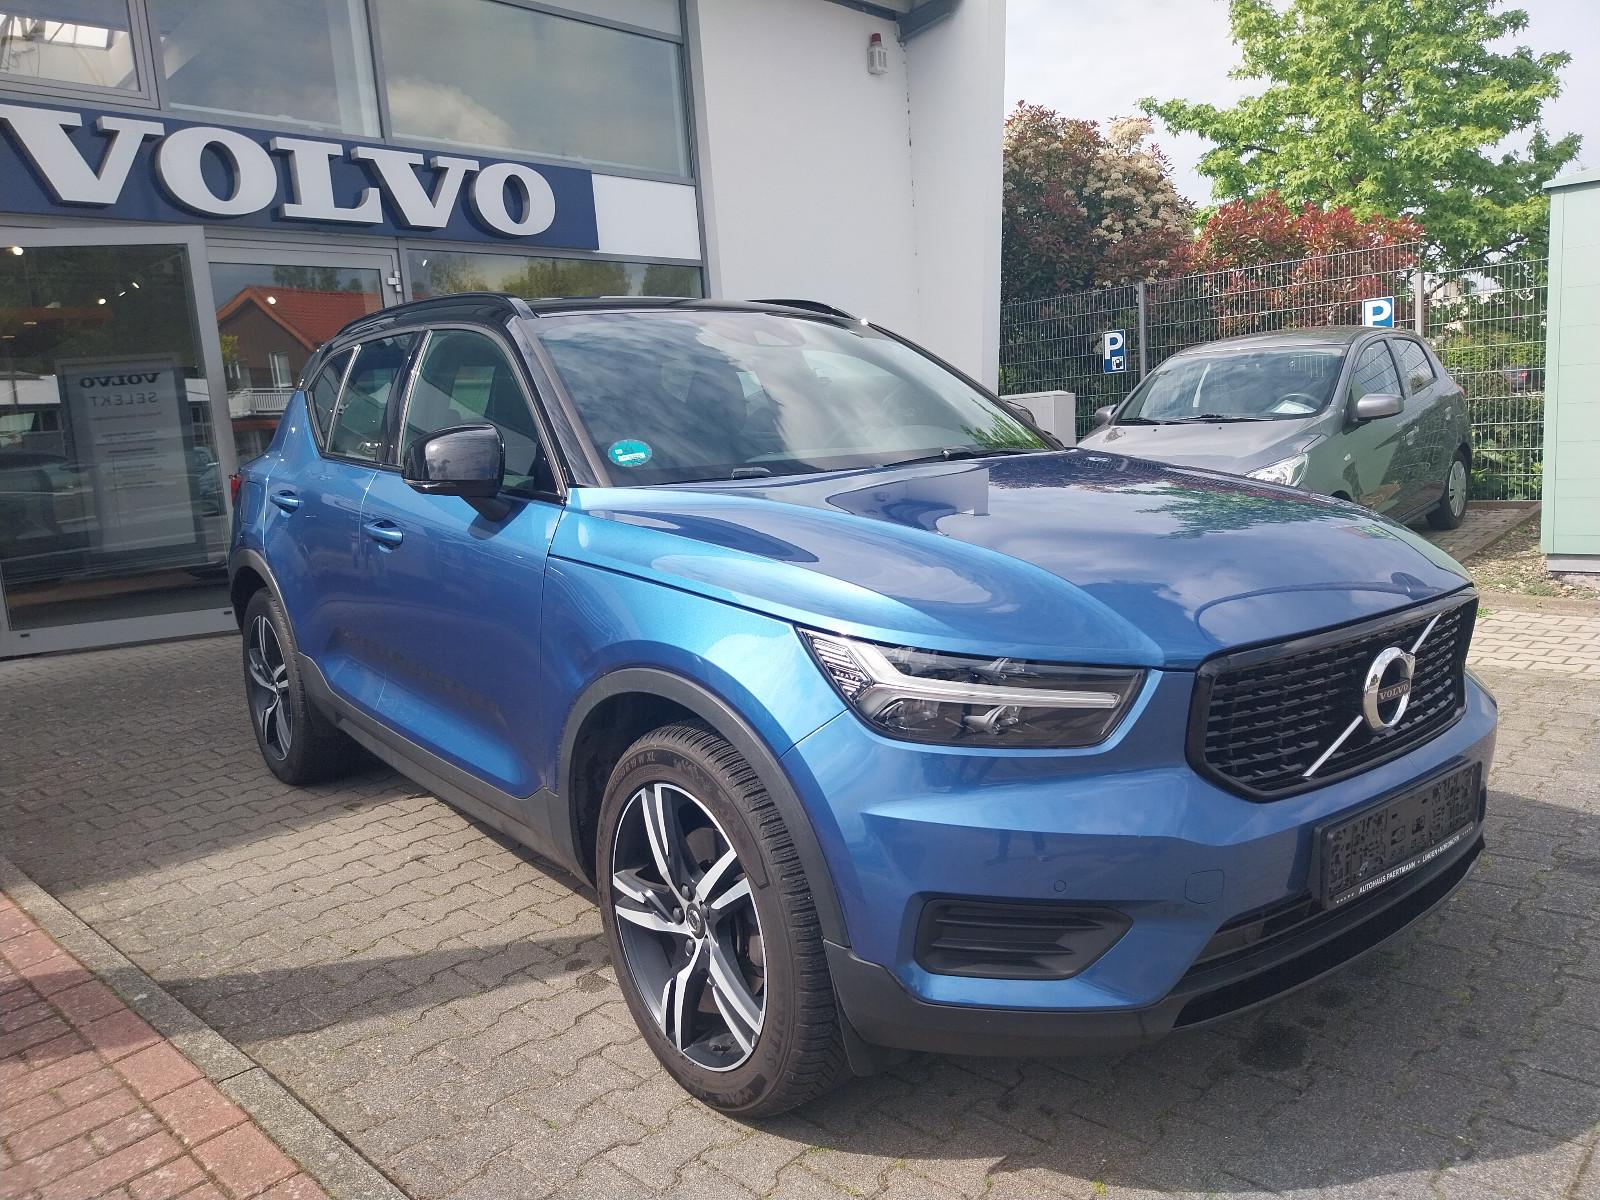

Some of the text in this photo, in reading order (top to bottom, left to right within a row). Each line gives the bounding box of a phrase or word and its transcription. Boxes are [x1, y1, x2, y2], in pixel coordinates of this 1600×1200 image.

[0, 103, 556, 236] VOLVO
[1364, 299, 1392, 327] P
[1104, 331, 1123, 360] P
[1380, 683, 1409, 700] VOLVO
[1358, 875, 1386, 895] AUTOHAUS
